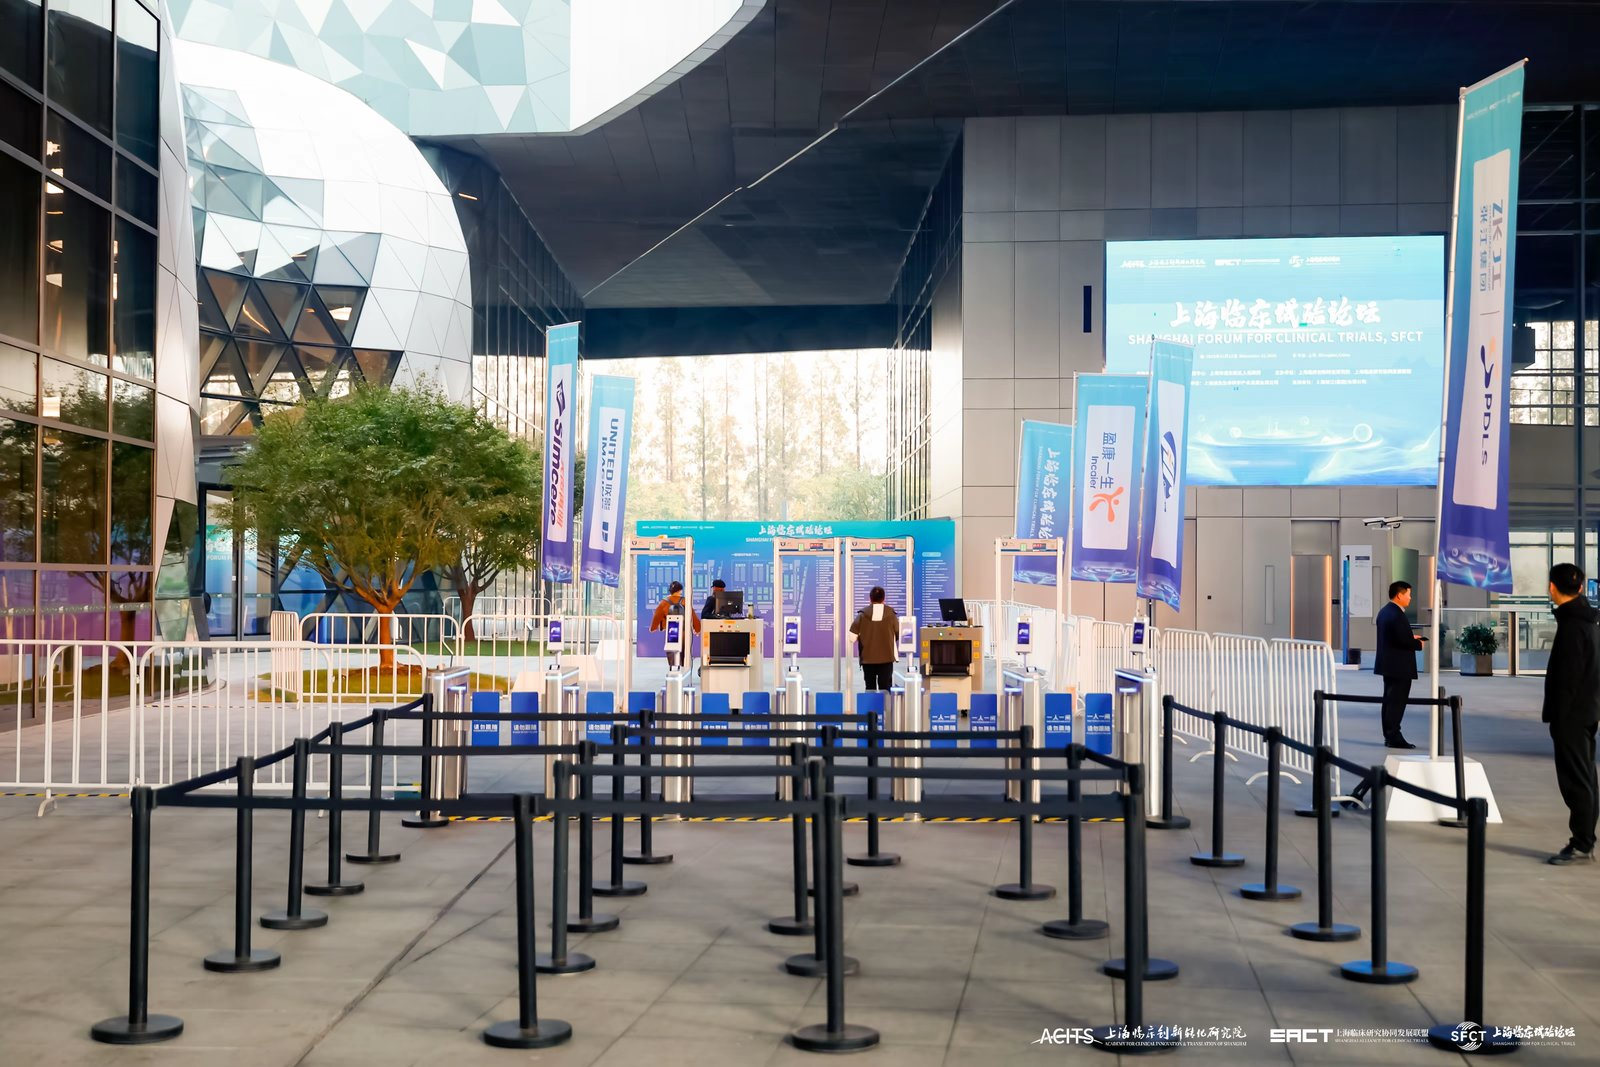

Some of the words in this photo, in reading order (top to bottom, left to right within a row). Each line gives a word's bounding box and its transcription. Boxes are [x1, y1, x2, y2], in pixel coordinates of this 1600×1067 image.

[1169, 296, 1381, 330] 上海临床试验论坛
[1197, 333, 1242, 344] FORUM
[1246, 333, 1272, 344] FOR
[1276, 332, 1334, 343] CLINICAL
[1337, 332, 1388, 344] TRIALS,
[1391, 331, 1424, 342] SFCT
[606, 418, 618, 480] UNITED
[1482, 393, 1493, 465] PDLS
[550, 418, 564, 526] Simcere
[1090, 456, 1098, 489] Incaier
[1100, 432, 1116, 490] 盈康一生
[1038, 448, 1060, 539] 上海临床试验论
